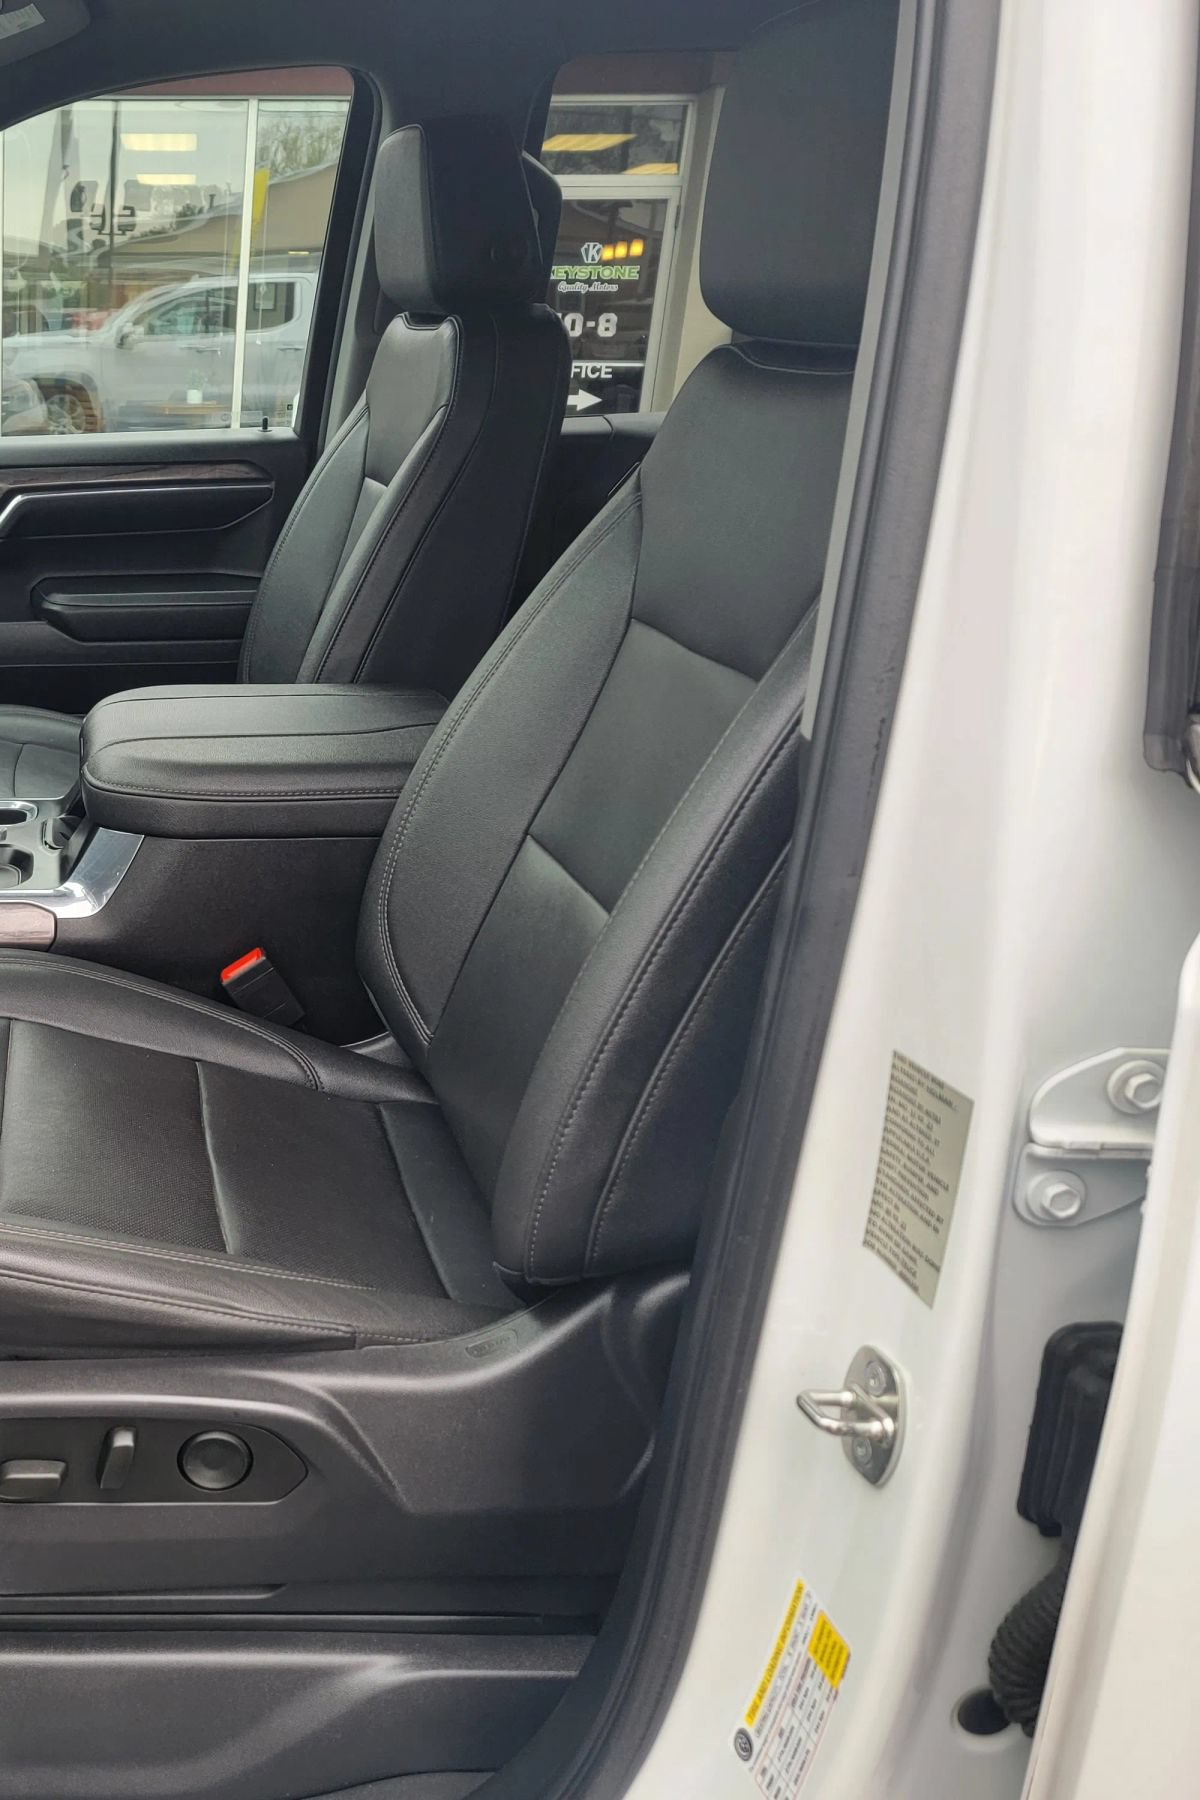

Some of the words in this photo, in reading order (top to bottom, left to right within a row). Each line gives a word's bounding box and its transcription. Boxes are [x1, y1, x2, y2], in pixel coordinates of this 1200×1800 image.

[557, 281, 589, 293] Quality
[589, 281, 619, 292] Motors
[557, 312, 618, 337] 0-8
